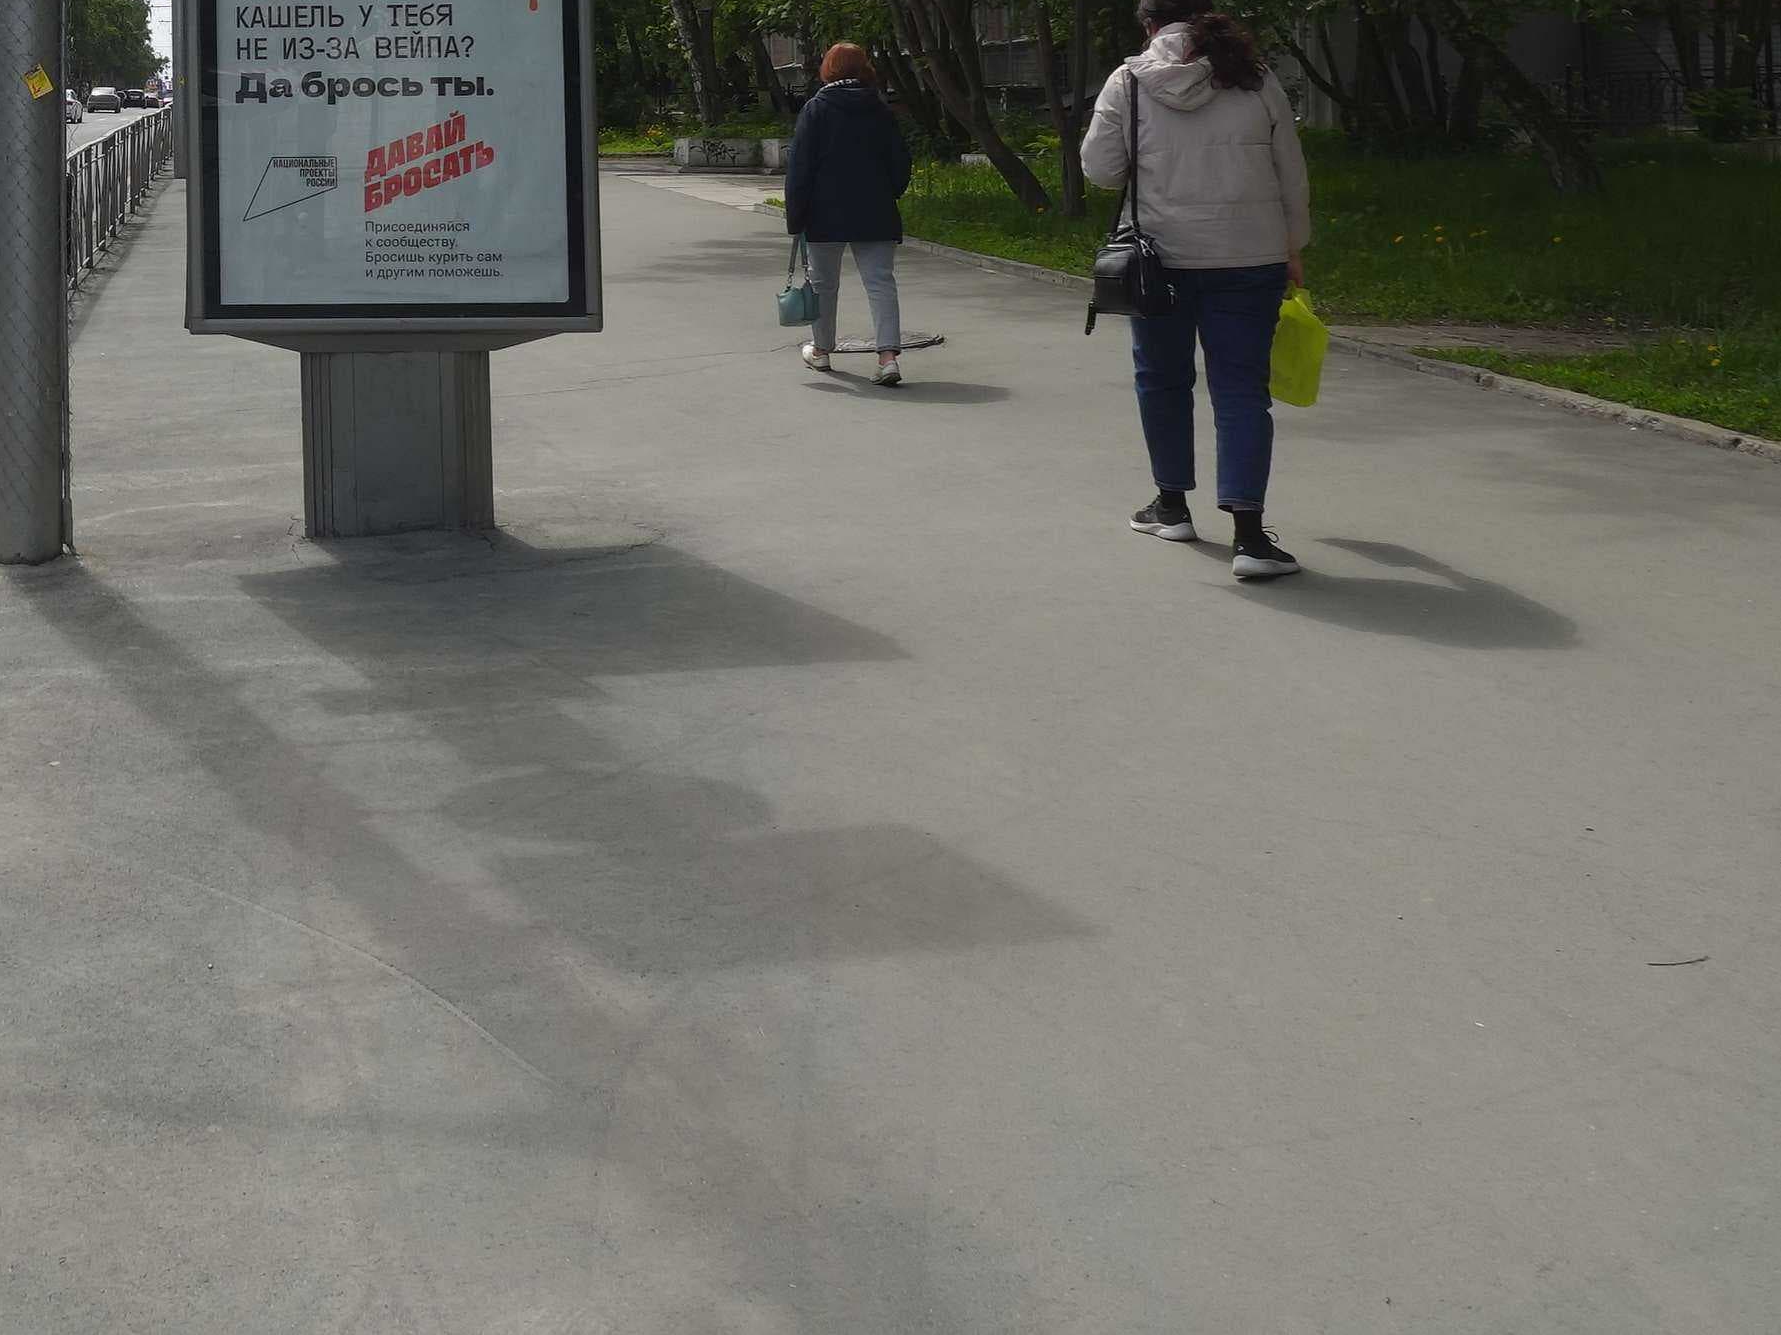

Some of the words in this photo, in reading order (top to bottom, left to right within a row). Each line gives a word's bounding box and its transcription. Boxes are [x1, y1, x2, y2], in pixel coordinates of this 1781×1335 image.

[235, 5, 344, 28] КАШЕЛЬ
[359, 4, 374, 27] У
[236, 37, 268, 60] НЕ
[283, 36, 360, 60] ИЗ-ЗА
[375, 31, 475, 59] ВЕЙПА?
[235, 72, 293, 104] Да
[301, 71, 424, 105] брось
[430, 76, 495, 97] ты.
[364, 110, 466, 183] ДАВАЙ
[273, 158, 334, 168] НАЦИОНАЛЬНЫЕ
[300, 168, 335, 177] ПРОЕКТЫ
[364, 141, 495, 213] БРОСАТЬ
[306, 178, 335, 187] РОССИИ
[365, 220, 470, 234] Присоединяйся
[365, 238, 372, 247] к
[376, 236, 458, 249] сообществу.
[365, 251, 425, 264] Бросишь
[428, 253, 473, 265] курить
[476, 252, 502, 263] сам
[365, 268, 373, 277] и
[377, 268, 425, 280] другим
[428, 267, 504, 278] поможешь.
